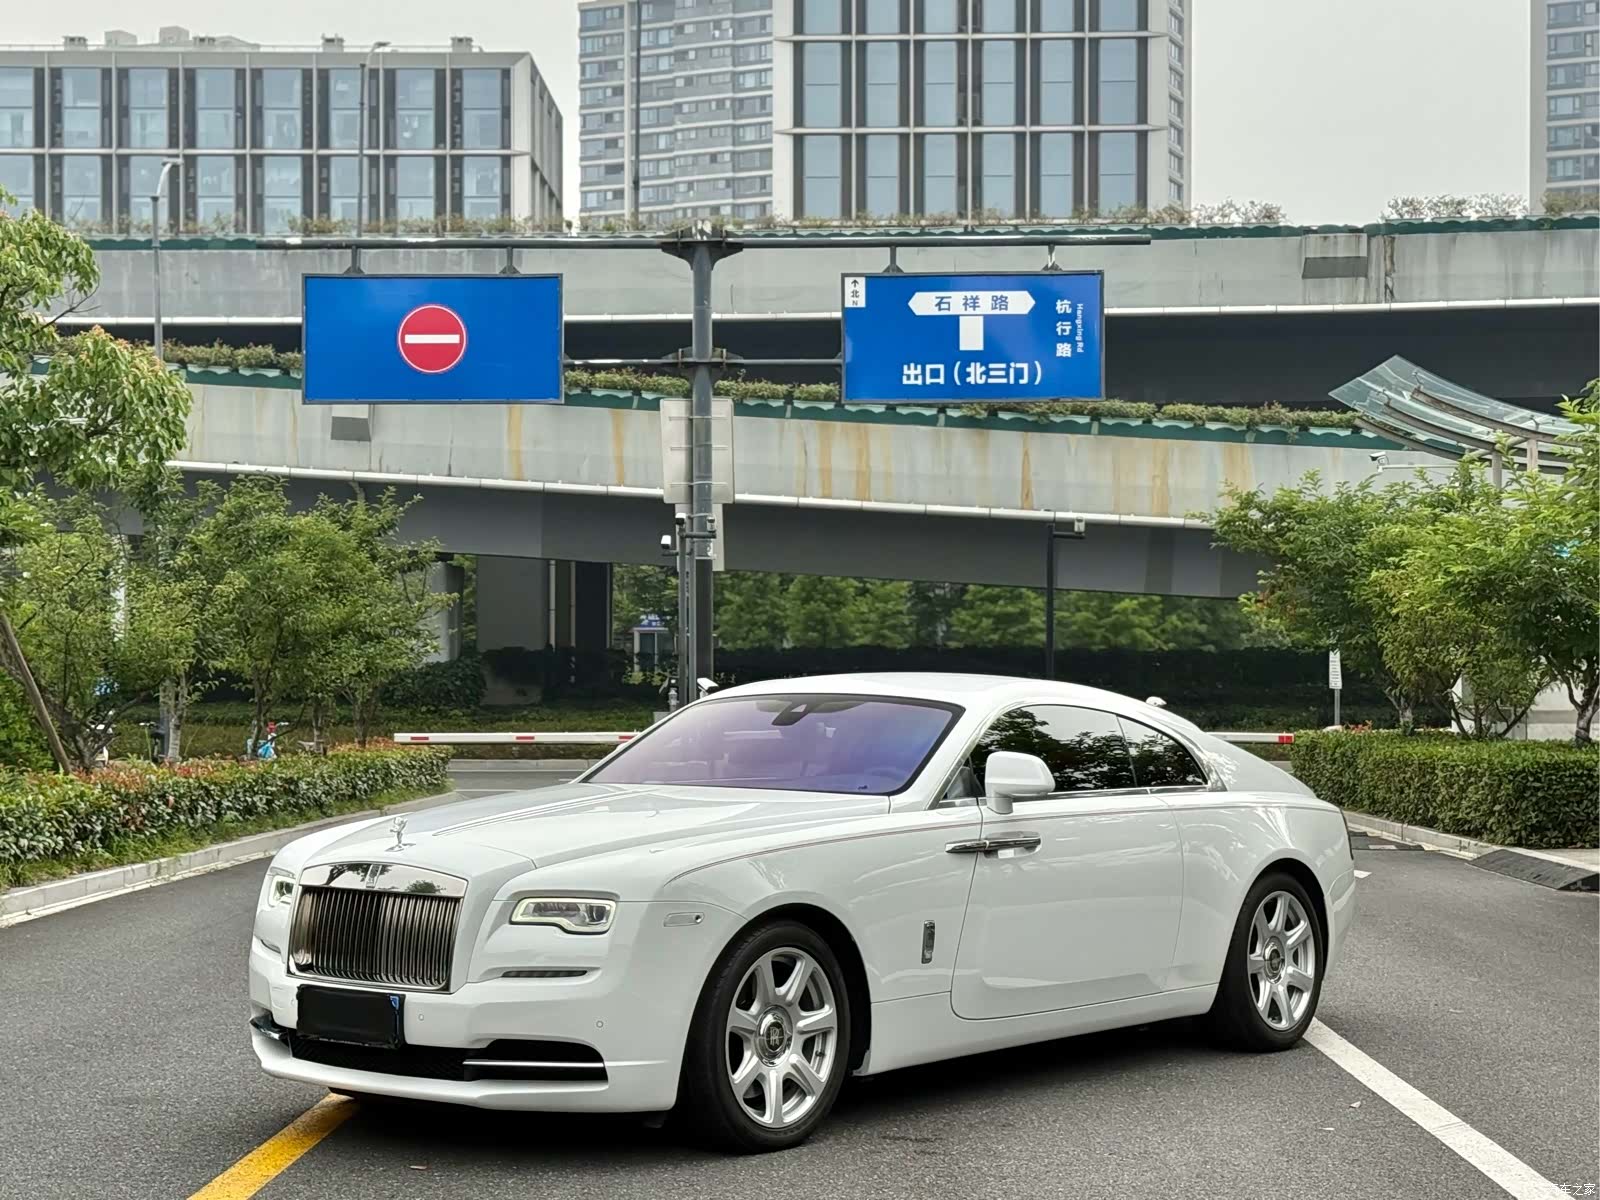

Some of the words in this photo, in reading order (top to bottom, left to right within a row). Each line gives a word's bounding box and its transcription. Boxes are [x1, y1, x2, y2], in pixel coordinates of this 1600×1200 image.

[850, 289, 860, 299] 北
[934, 294, 1010, 312] 石祥路
[1055, 299, 1073, 358] 杭行路
[1076, 342, 1084, 353] Rd
